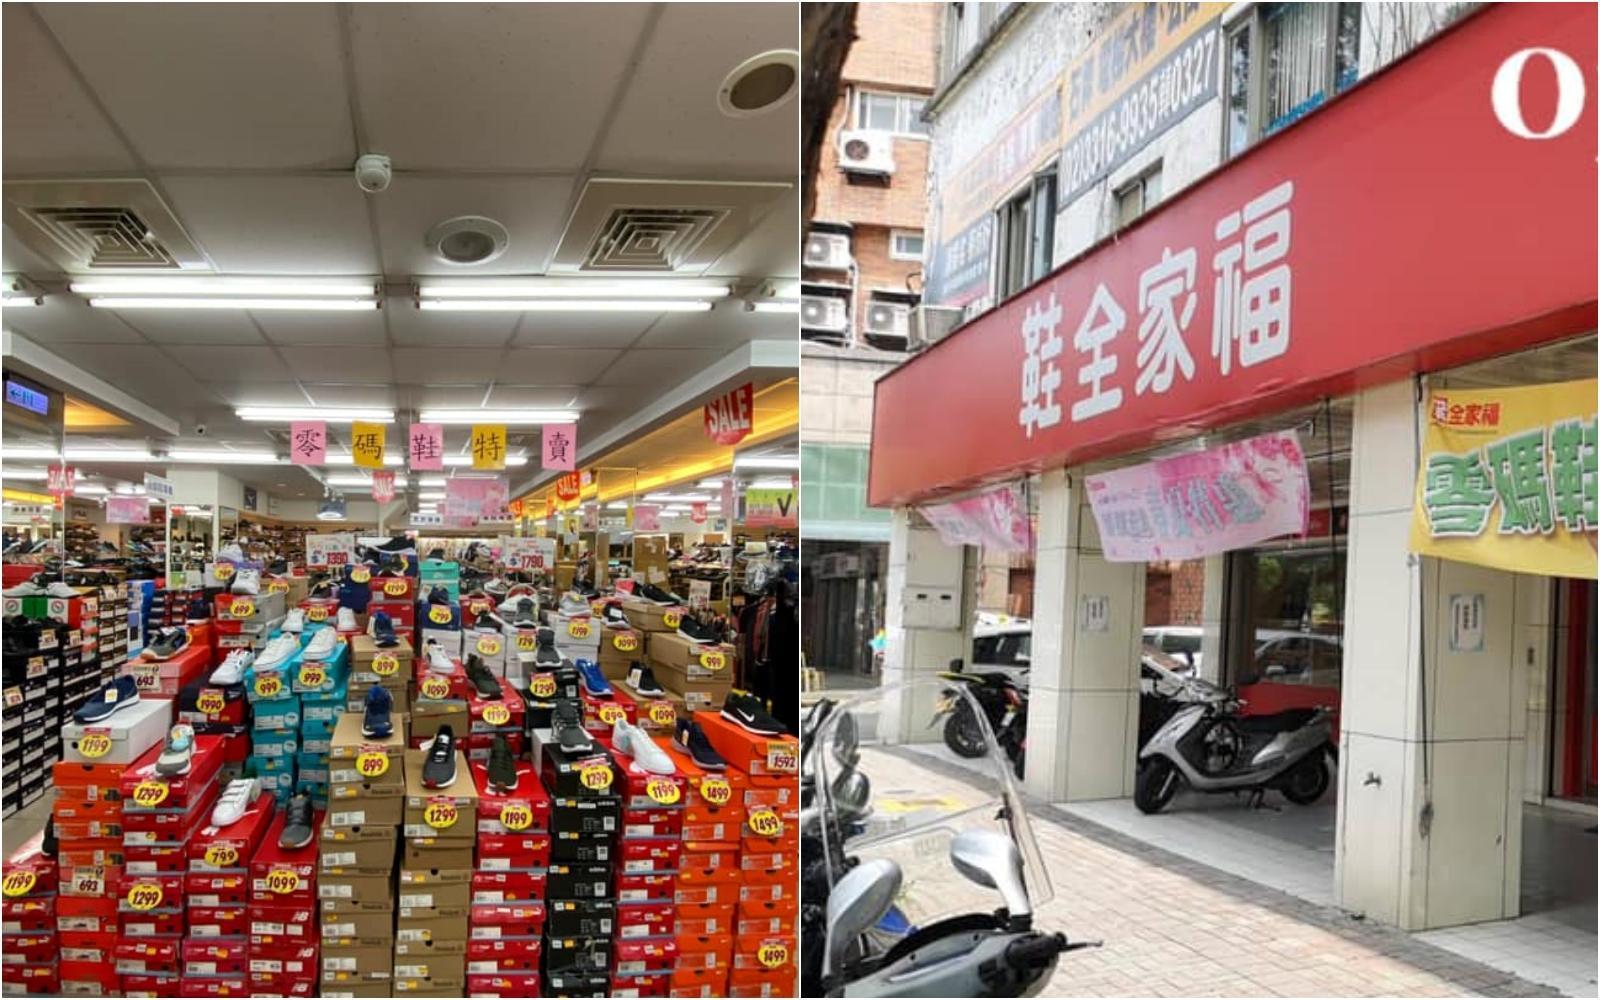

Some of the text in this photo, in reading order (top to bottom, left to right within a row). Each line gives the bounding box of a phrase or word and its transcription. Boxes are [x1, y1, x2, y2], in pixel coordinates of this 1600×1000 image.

[1020, 180, 1295, 438] 鞋全家福
[707, 389, 750, 433] SALE
[557, 474, 579, 496] SALE
[520, 555, 544, 568] 1790
[377, 660, 395, 671] 899
[136, 675, 154, 686] 693
[303, 671, 322, 683] 999
[260, 681, 277, 694] 999
[425, 683, 448, 695] 1099
[199, 700, 222, 710] 1990
[655, 710, 675, 721] 1099
[81, 738, 109, 752] 1199
[362, 758, 384, 771] 899
[774, 756, 796, 769] 1592
[136, 786, 164, 802] 1299
[653, 783, 675, 798] 1199
[706, 786, 729, 799] 1499
[430, 809, 456, 822] 1299
[505, 812, 528, 825] 1199
[752, 814, 778, 830] 1499
[211, 851, 235, 862] 799
[5, 875, 31, 889] 1199
[79, 880, 98, 891] 693
[268, 876, 297, 889] 1099
[132, 892, 159, 905] 1299
[763, 948, 786, 962] 1499
